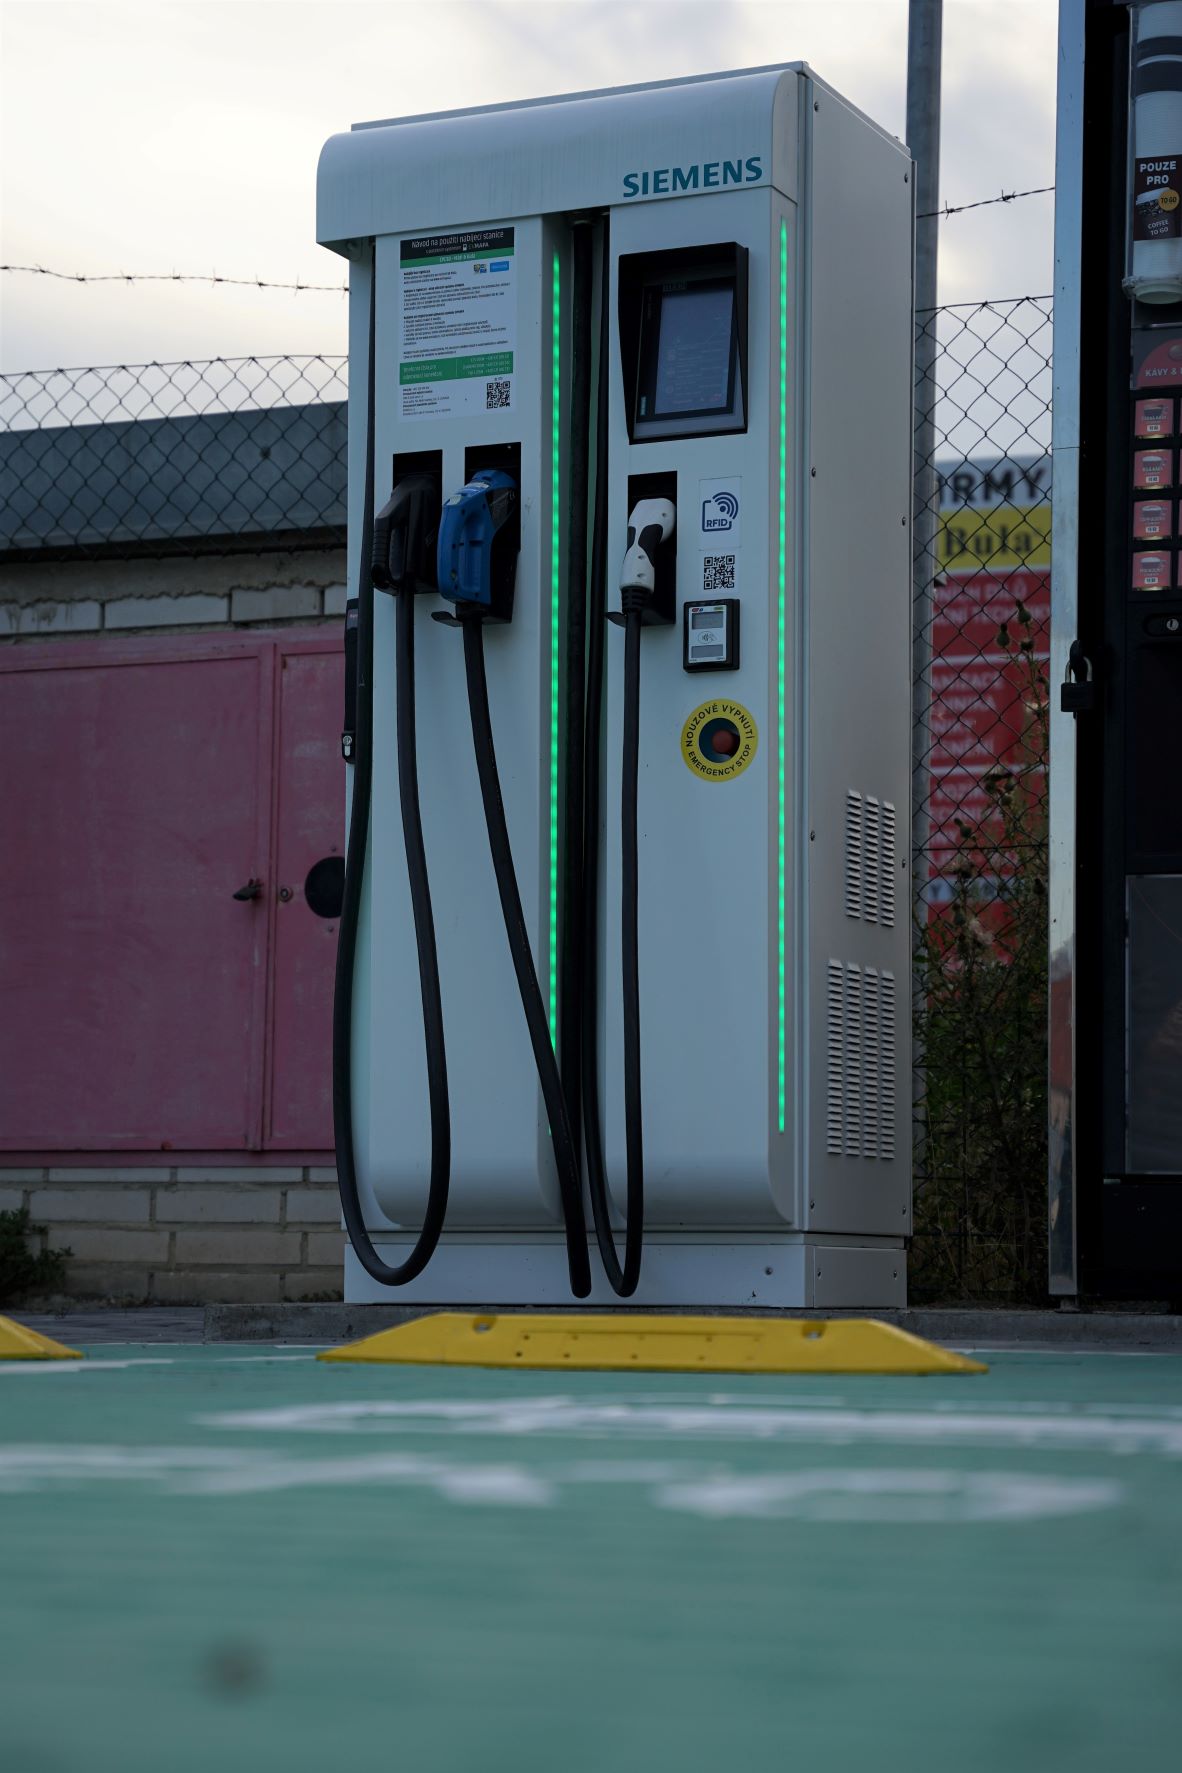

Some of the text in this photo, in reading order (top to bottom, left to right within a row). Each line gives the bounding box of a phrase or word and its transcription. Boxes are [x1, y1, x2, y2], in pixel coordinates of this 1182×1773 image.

[1139, 160, 1177, 173] POUZE
[623, 156, 763, 198] SIEMENS
[1146, 174, 1169, 185] PRO
[1147, 219, 1169, 229] COFFEE
[411, 240, 430, 249] Návod
[483, 231, 504, 240] stanice
[706, 518, 728, 528] RFID
[685, 703, 755, 748] NOUZOVÉ VYPNUTÍ
[688, 744, 751, 776] EMERGENCY STOP
